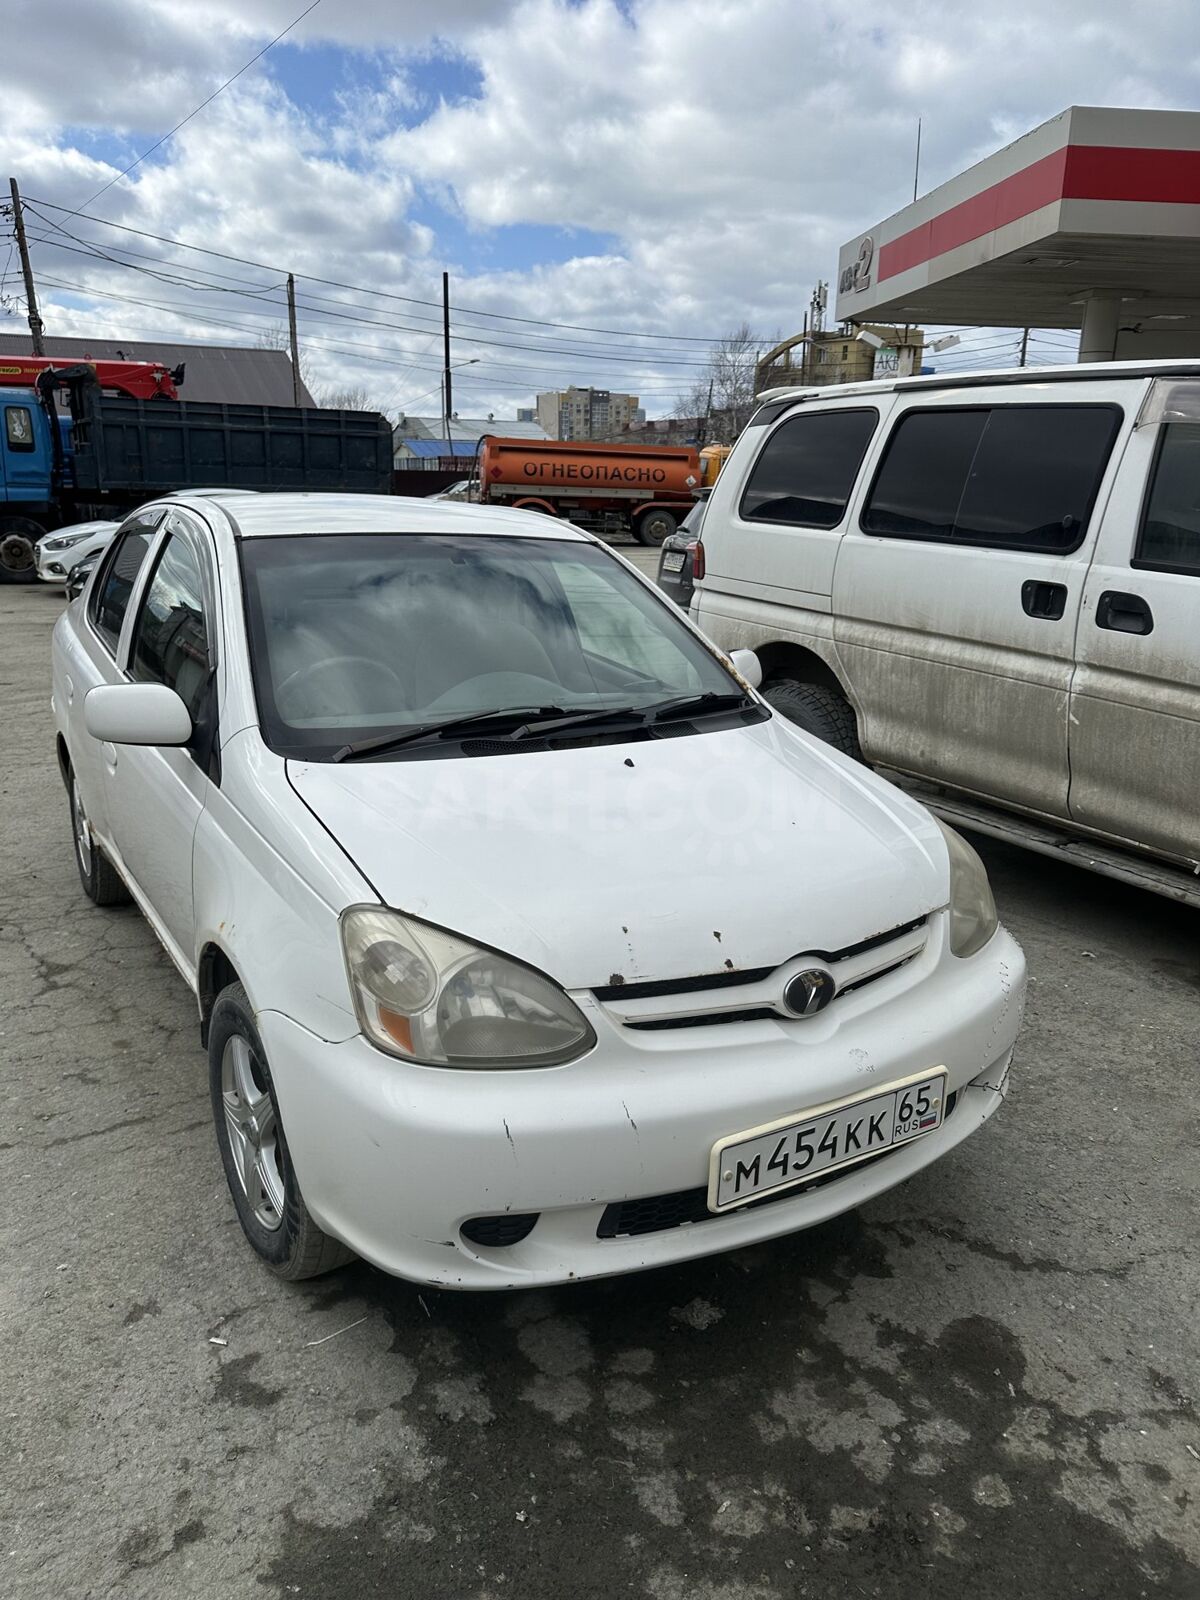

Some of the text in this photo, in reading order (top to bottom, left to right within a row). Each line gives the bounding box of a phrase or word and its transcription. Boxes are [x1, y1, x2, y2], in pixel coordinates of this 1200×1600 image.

[523, 462, 666, 483] ОГНЕОПАСНО
[895, 1119, 919, 1137] RUS
[734, 1085, 931, 1193] М454КК 65
